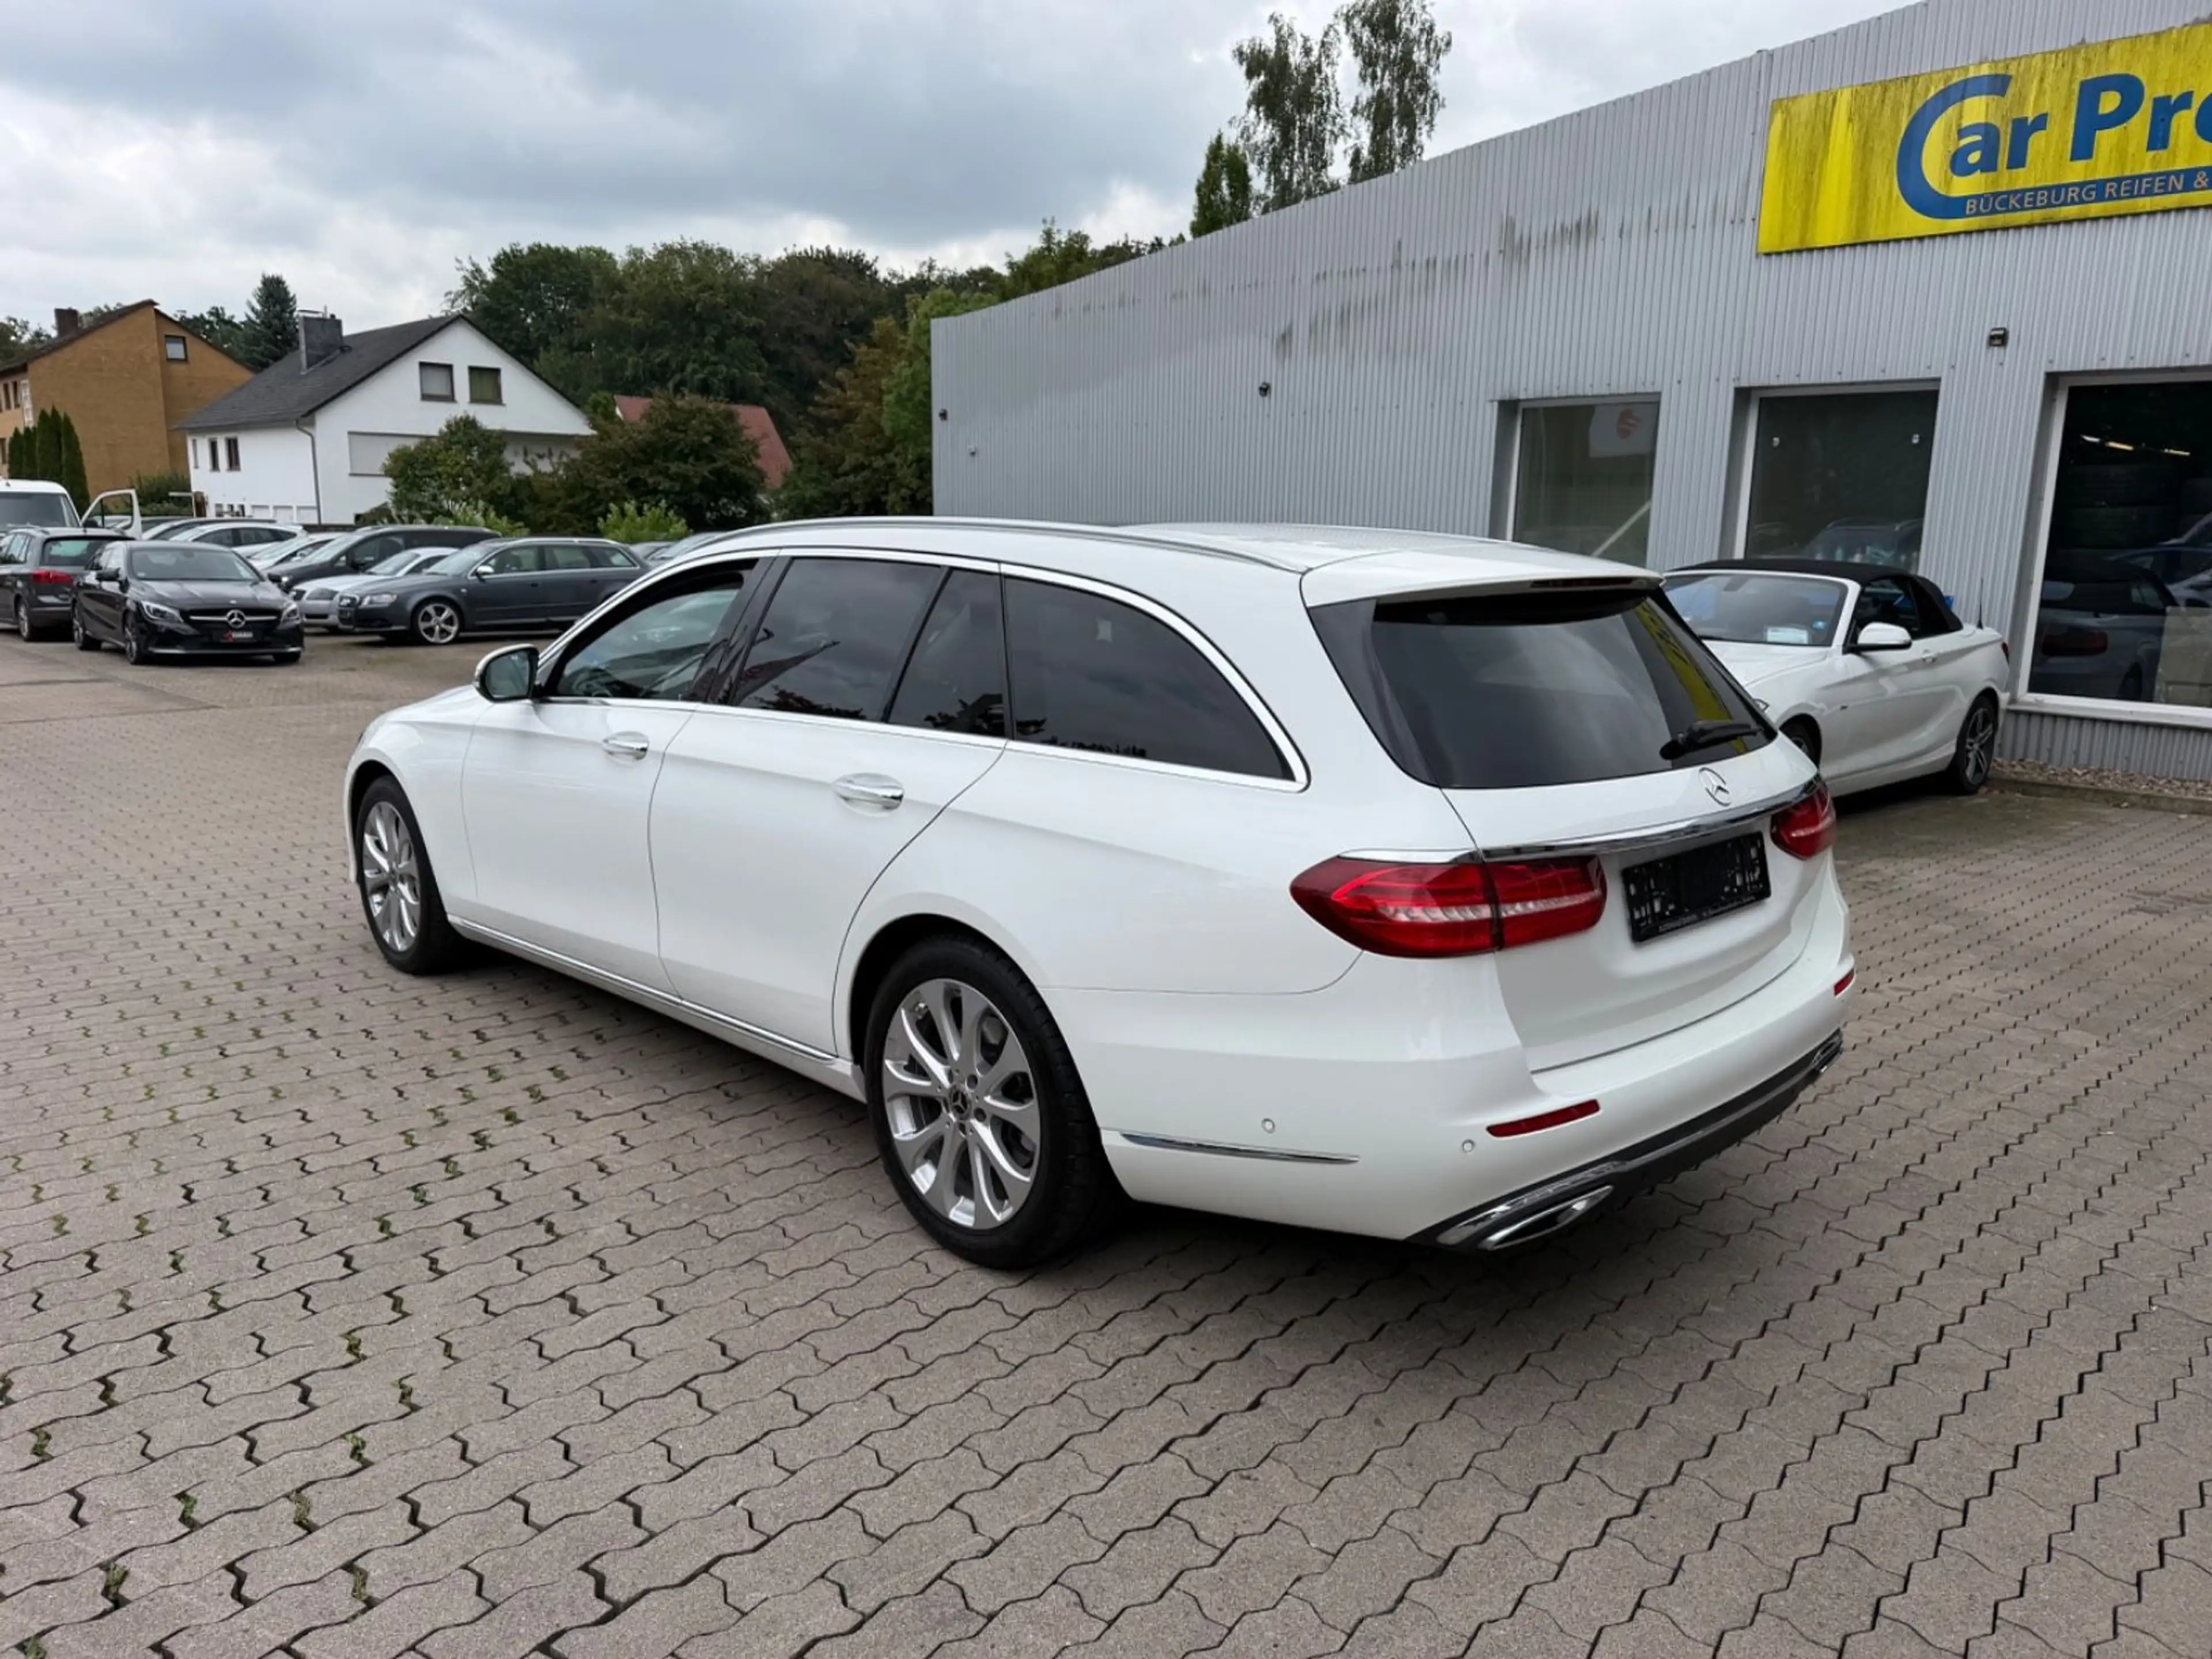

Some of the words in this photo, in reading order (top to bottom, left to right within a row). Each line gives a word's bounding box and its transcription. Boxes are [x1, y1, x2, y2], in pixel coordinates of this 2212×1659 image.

[1896, 74, 2049, 219] Car
[1965, 184, 2097, 215] BÜCKEBURG
[2104, 173, 2185, 199] REIFEN
[2192, 170, 2210, 190] &
